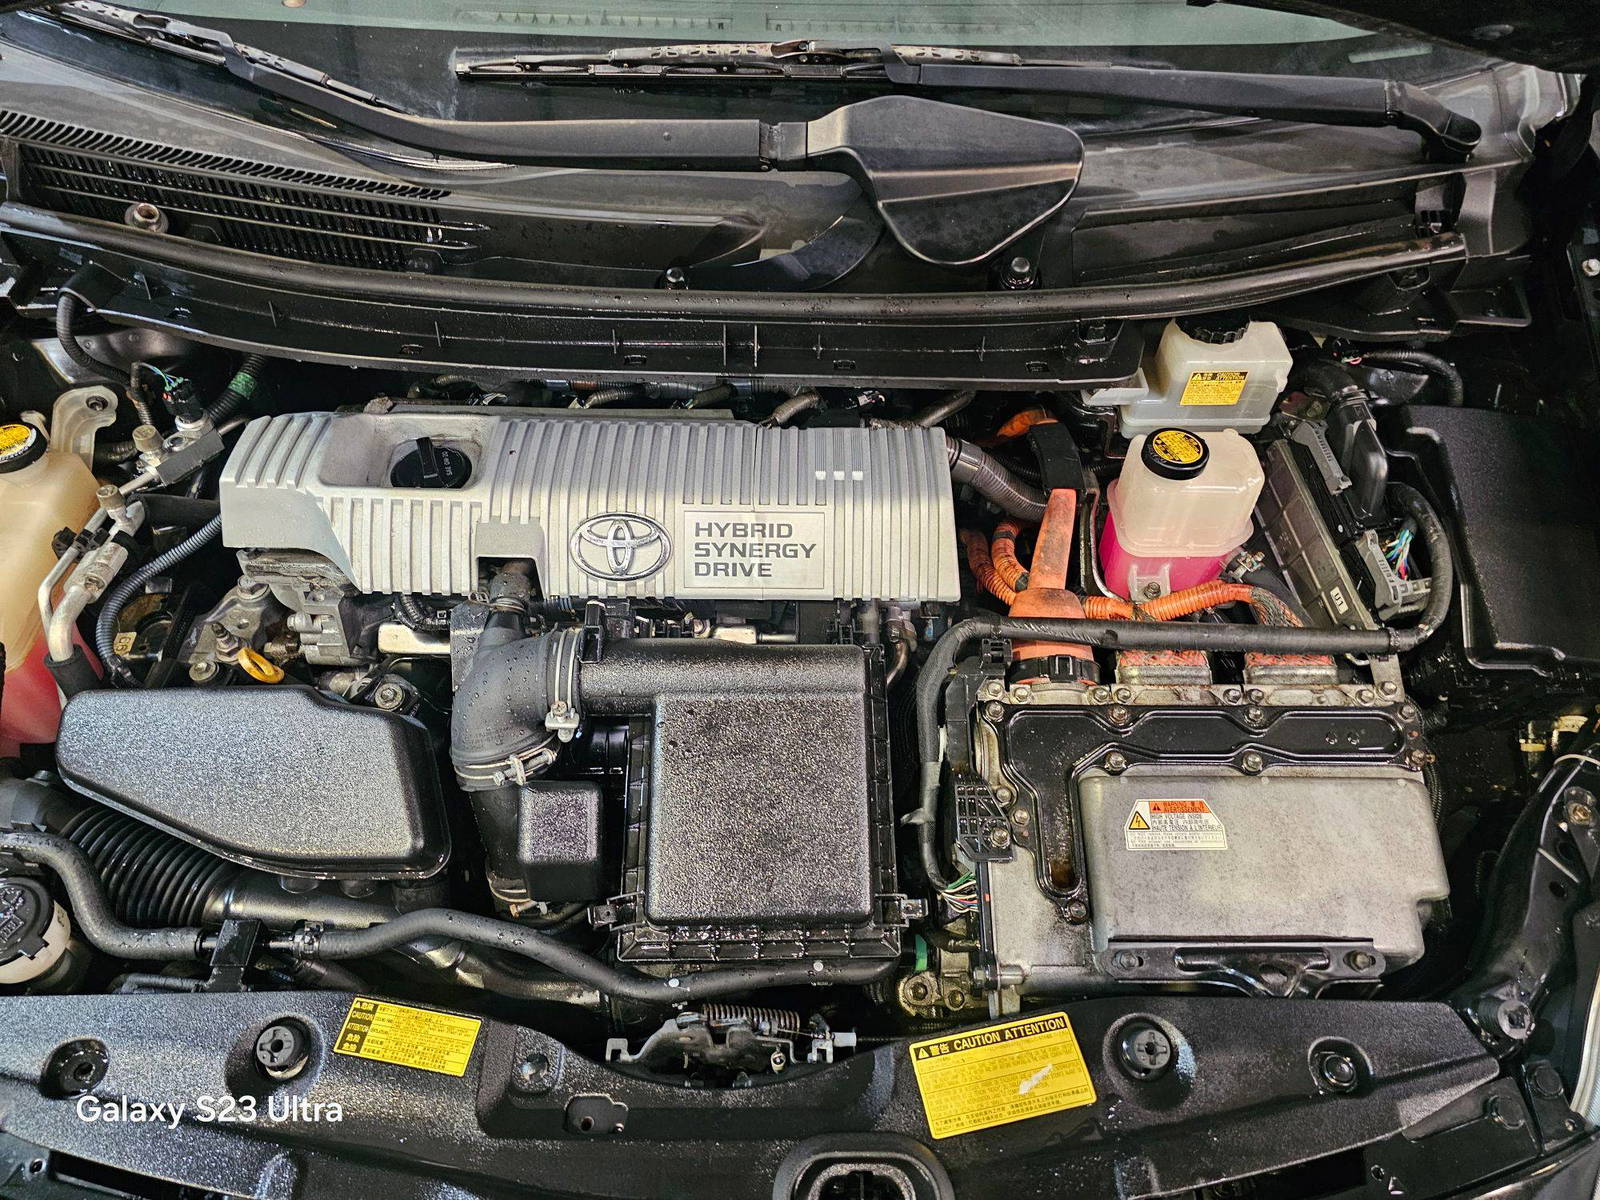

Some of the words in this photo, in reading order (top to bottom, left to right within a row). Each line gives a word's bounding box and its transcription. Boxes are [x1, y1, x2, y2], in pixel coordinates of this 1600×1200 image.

[694, 522, 793, 539] HYBRID
[694, 542, 817, 558] SYNERGY
[694, 562, 772, 577] DRIVE
[352, 1010, 375, 1021] CAUTION
[953, 1031, 1001, 1051] CAUTION
[1004, 1017, 1066, 1040] ATTENTION
